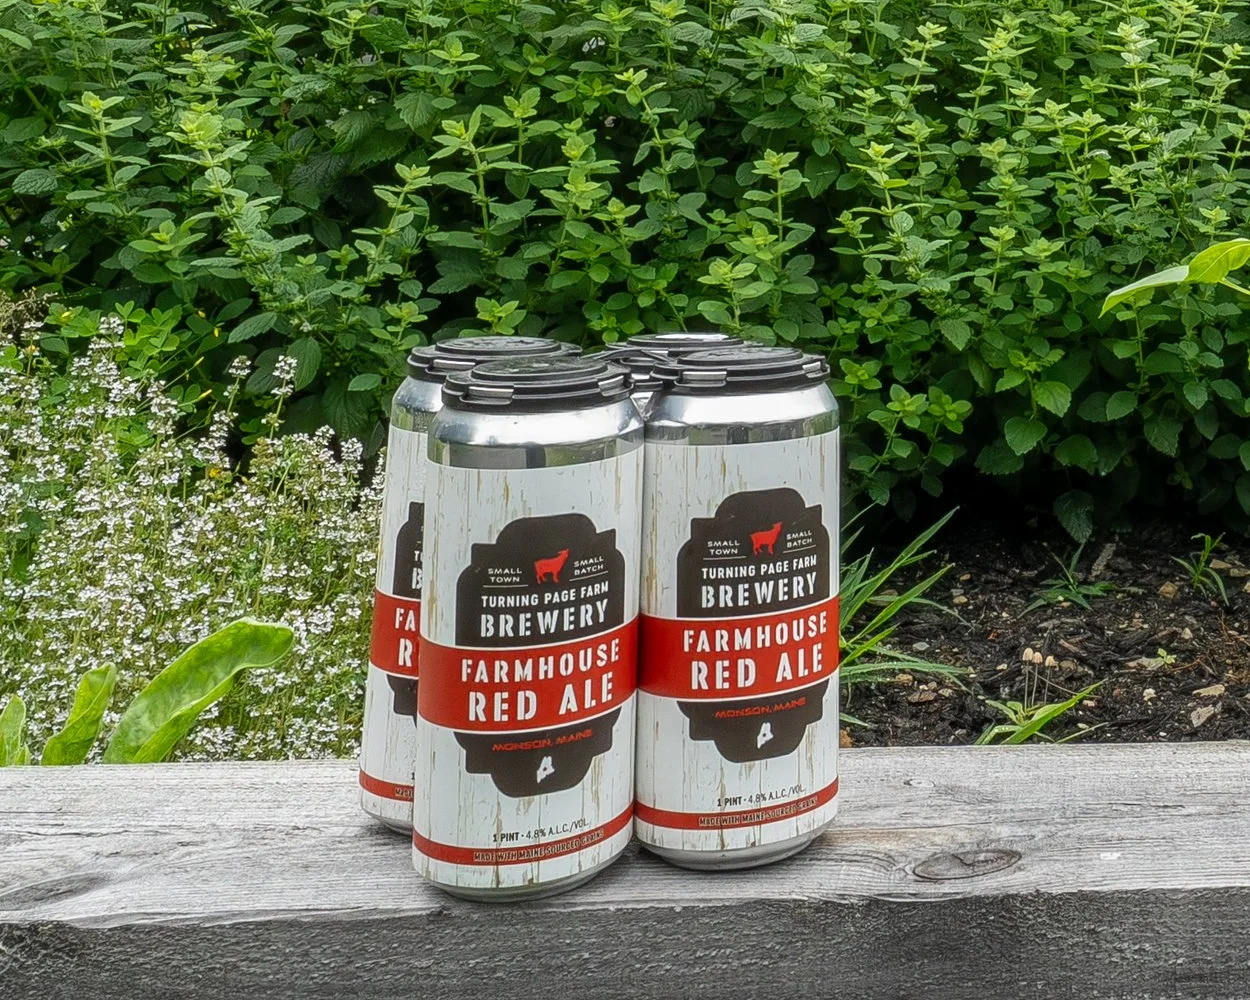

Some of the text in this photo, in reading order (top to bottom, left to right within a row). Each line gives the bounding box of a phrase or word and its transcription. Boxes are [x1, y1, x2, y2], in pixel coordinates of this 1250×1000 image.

[786, 530, 813, 540] SMALL
[707, 540, 740, 548] SMALL
[786, 538, 813, 548] BATCH
[709, 548, 739, 556] TOWN
[573, 556, 604, 568] SMALL
[701, 554, 817, 579] TURNING PAGE FARM
[487, 567, 523, 575] SMALL
[574, 564, 604, 576] BATCH
[489, 576, 521, 584] TOWN
[481, 580, 609, 608] TURNING PAGE FARM
[701, 571, 817, 609] BREWERY
[480, 598, 608, 638] BREWERY
[683, 611, 827, 653] FARMHOUSE
[461, 638, 619, 683] FARMHOUSE
[691, 642, 823, 690] RED ALE
[468, 671, 613, 722] RED ALE
[773, 697, 808, 712] MAINE
[556, 729, 593, 744] MAINE
[717, 799, 722, 807] 1
[724, 796, 742, 807] PINT
[747, 792, 767, 804] 4.8%
[699, 817, 720, 827] MADE
[721, 816, 741, 825] WITH
[741, 812, 765, 823] MAINE
[493, 834, 498, 842] 1
[500, 832, 519, 842] PINT
[525, 828, 546, 840] 4.8%
[474, 852, 495, 862] MADE
[496, 852, 517, 861] WITH
[519, 848, 544, 860] MAINE
